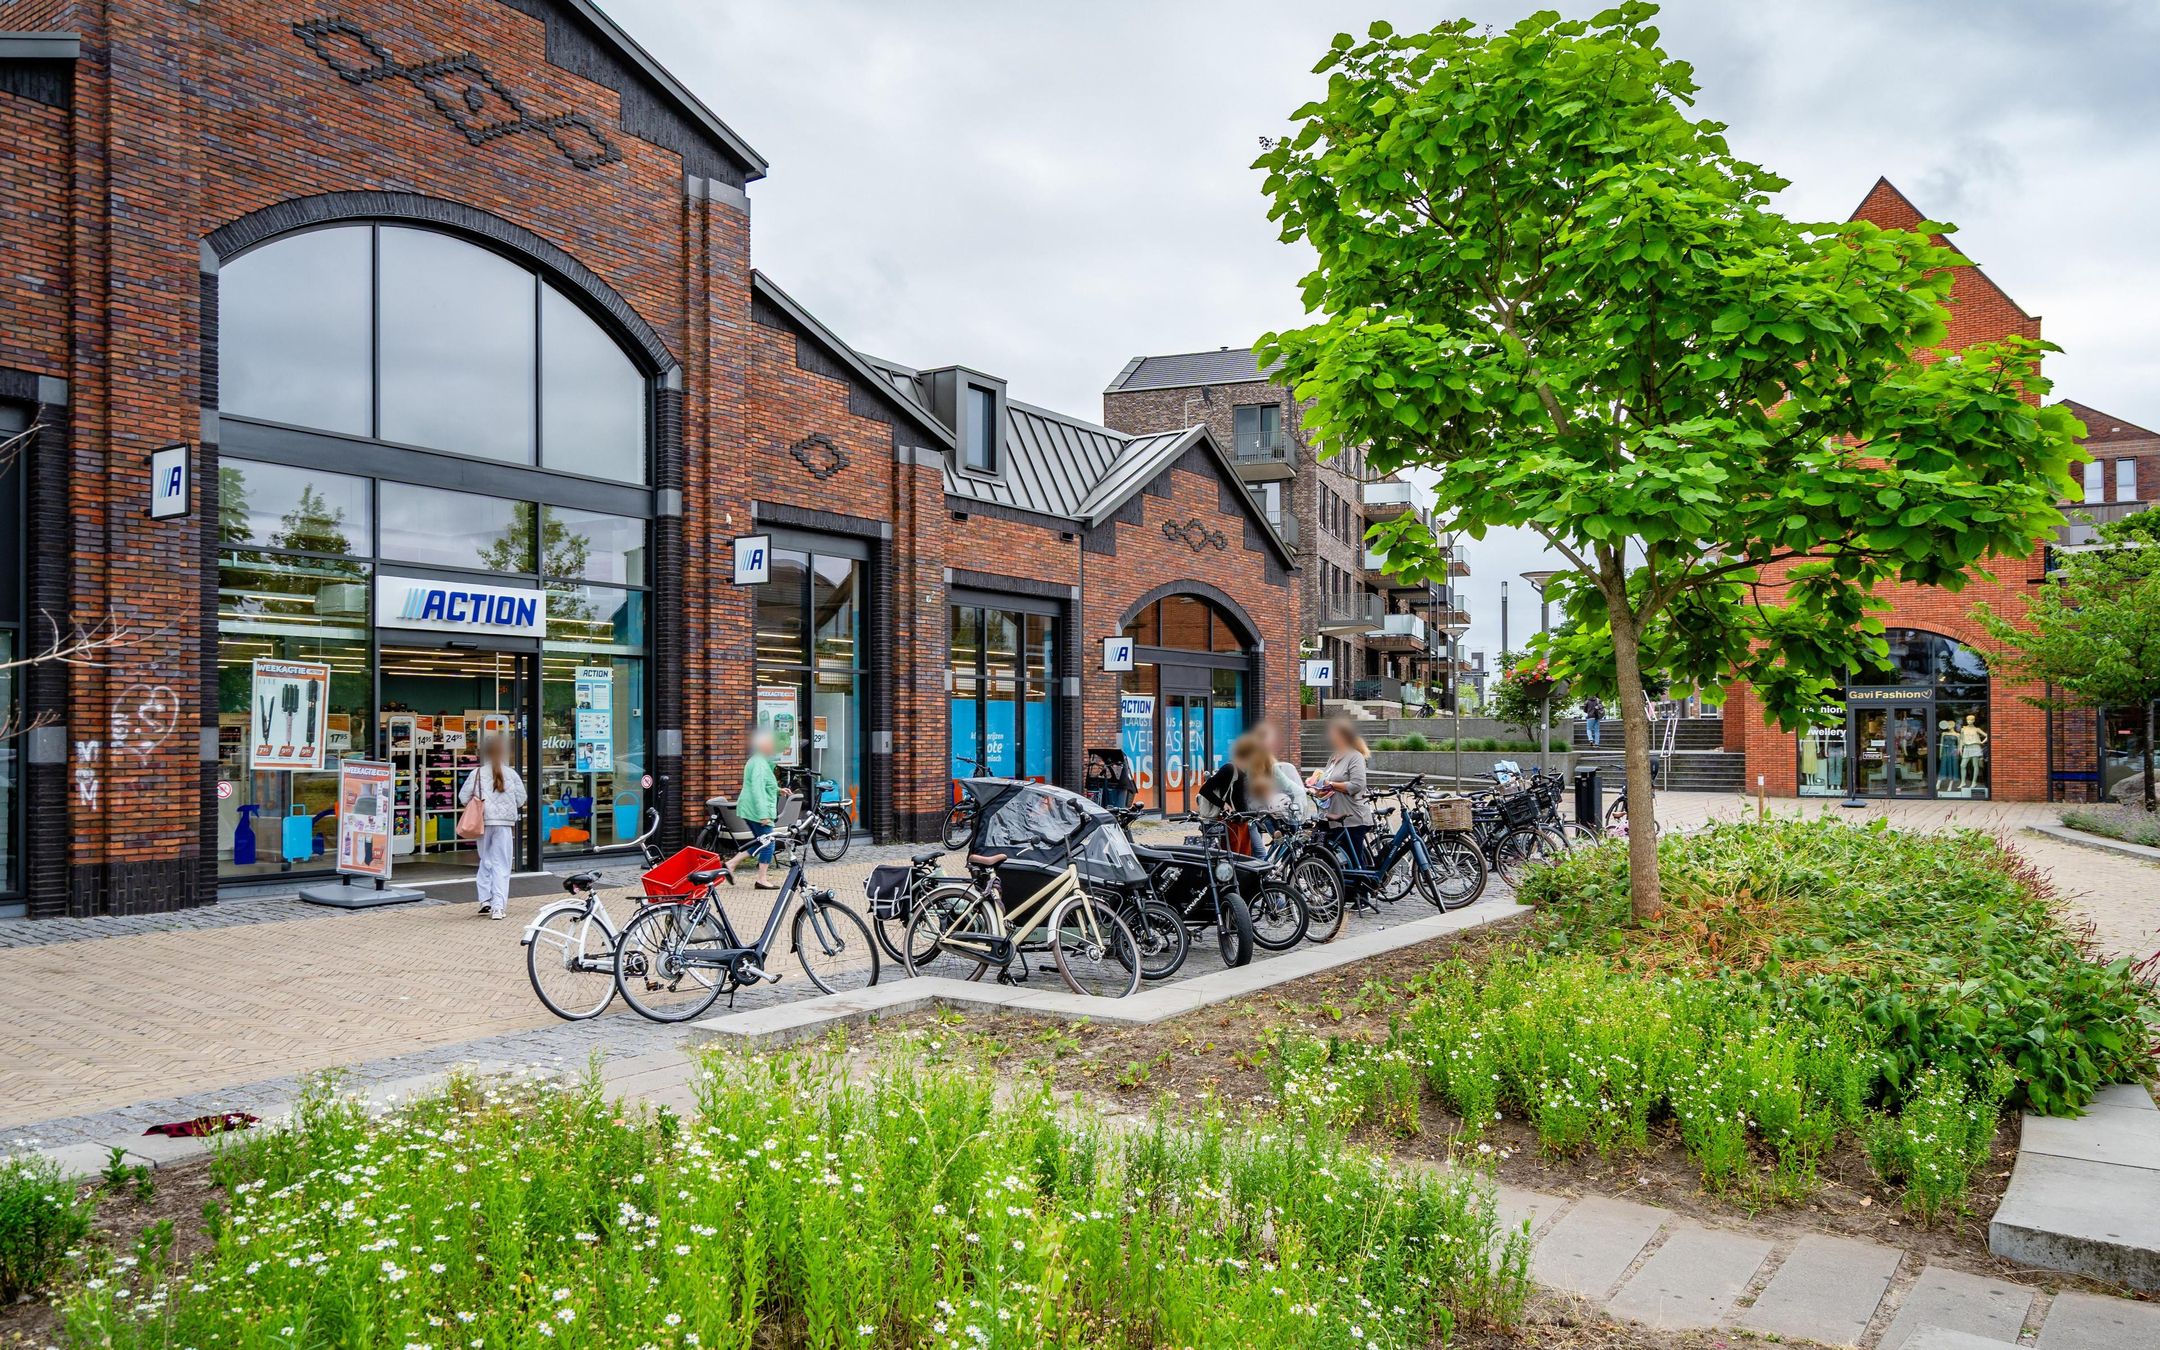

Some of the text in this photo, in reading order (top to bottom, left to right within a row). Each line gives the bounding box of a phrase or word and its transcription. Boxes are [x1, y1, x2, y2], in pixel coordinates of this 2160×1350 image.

[168, 465, 182, 497] A
[750, 549, 763, 570] A
[421, 590, 537, 627] ACTION
[257, 664, 307, 675] WEEKACTIE
[583, 669, 609, 678] ACTION
[1848, 690, 1921, 699] Gavi Fashion
[1121, 700, 1152, 714] ACTION
[542, 736, 576, 749] elkom
